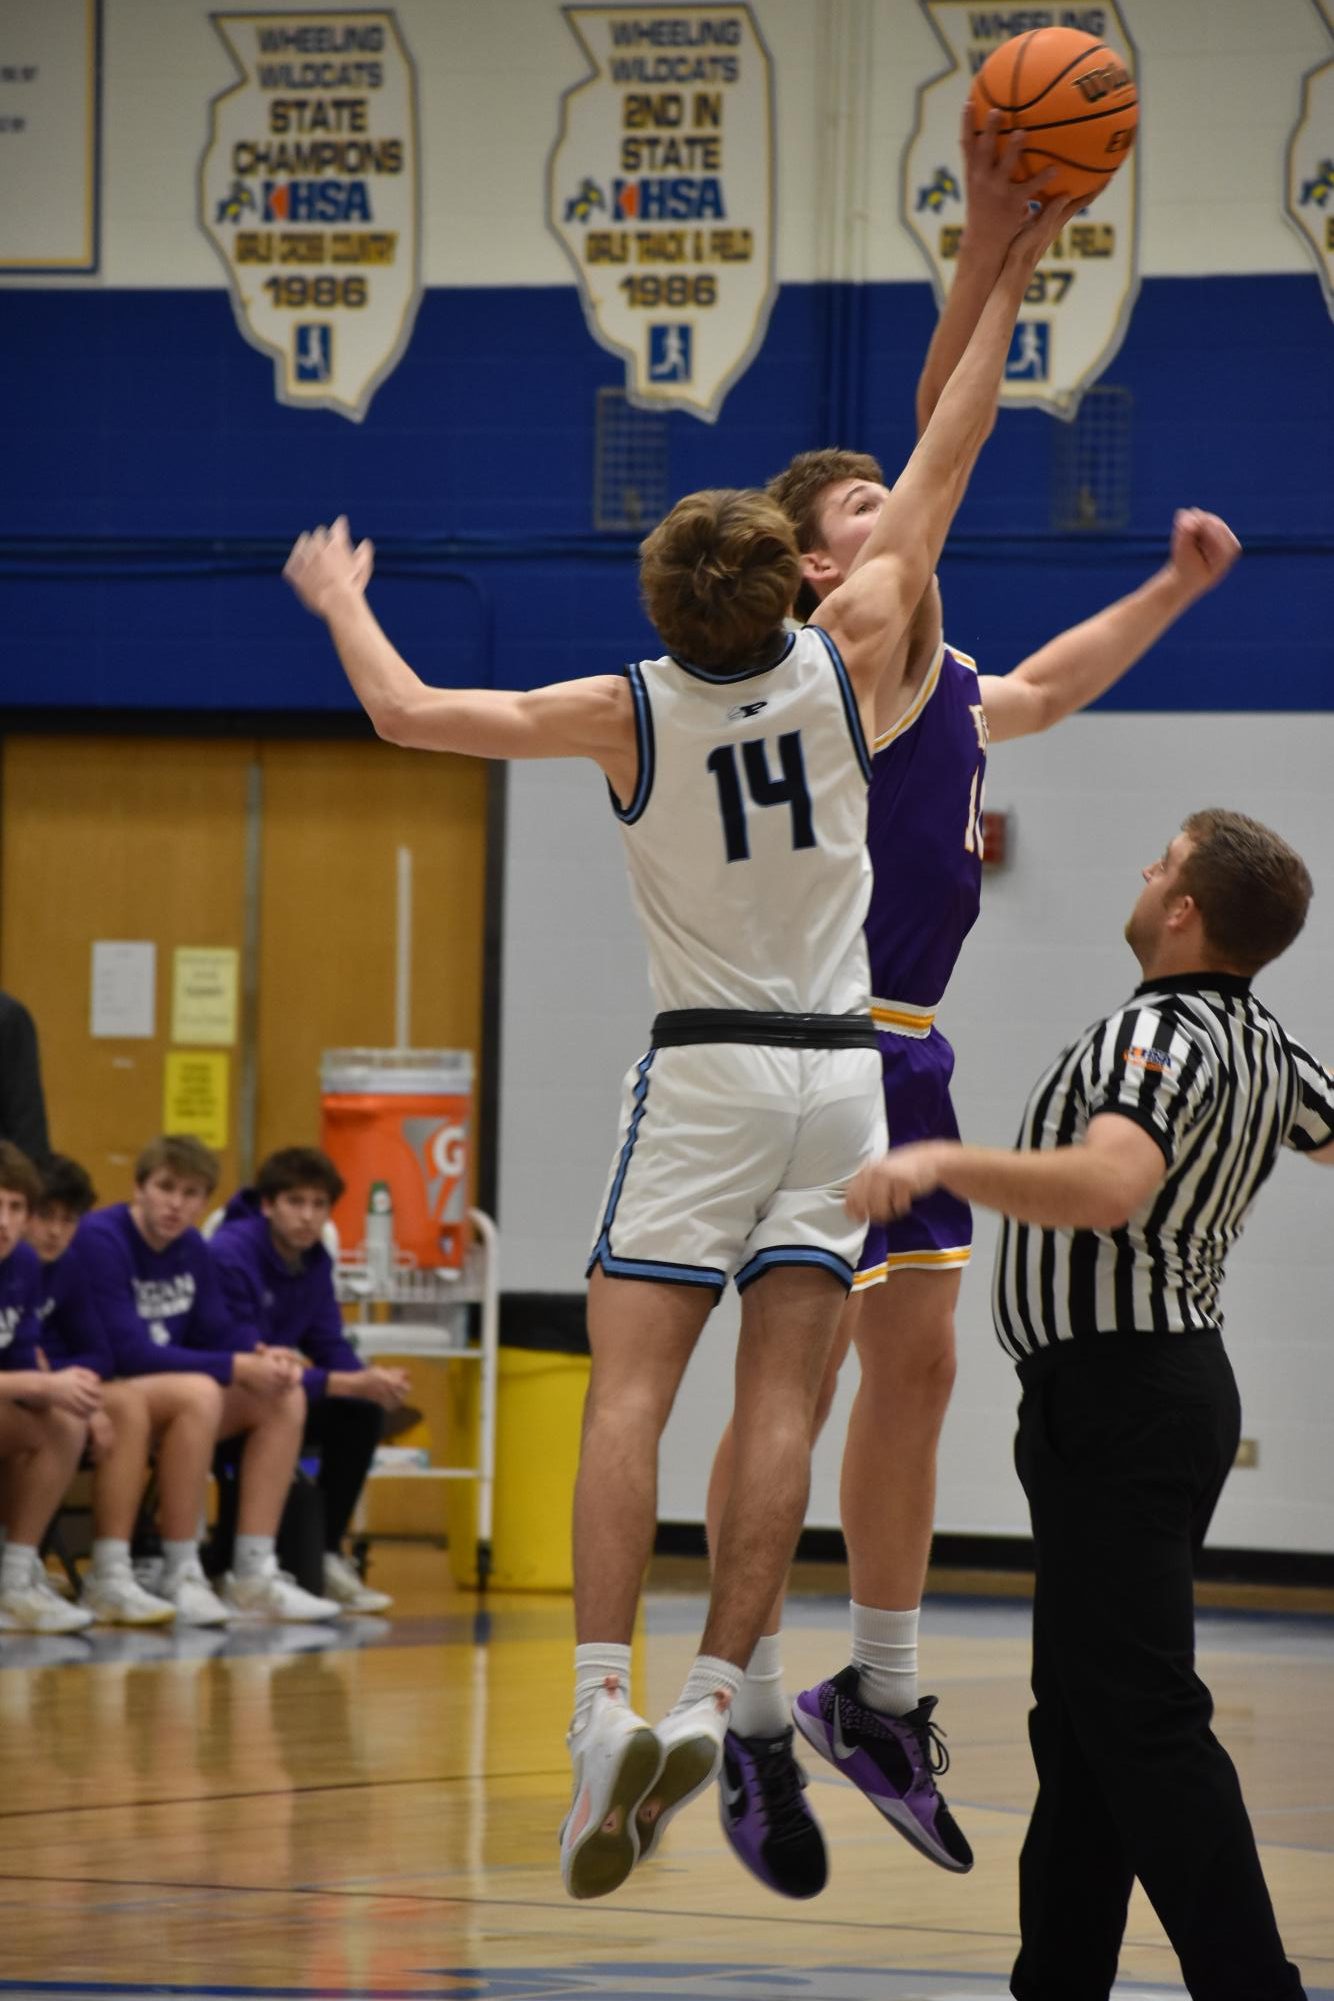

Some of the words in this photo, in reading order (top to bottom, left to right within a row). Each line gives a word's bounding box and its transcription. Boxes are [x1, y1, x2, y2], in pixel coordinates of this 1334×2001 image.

[259, 25, 385, 54] WHEELING
[611, 19, 740, 47] WHEELING
[259, 62, 383, 89] WILDCATS
[611, 55, 738, 83] WILDCATS
[270, 98, 368, 134] STATE
[624, 94, 681, 129] 2ND
[693, 93, 721, 127] IN
[233, 140, 403, 176] CHAMPIONS
[622, 136, 720, 171] STATE
[264, 275, 367, 308] 1986
[619, 274, 717, 307] 1986
[1023, 271, 1075, 303] 87
[739, 701, 768, 718] P
[707, 729, 817, 864] 14
[432, 1126, 465, 1176] G
